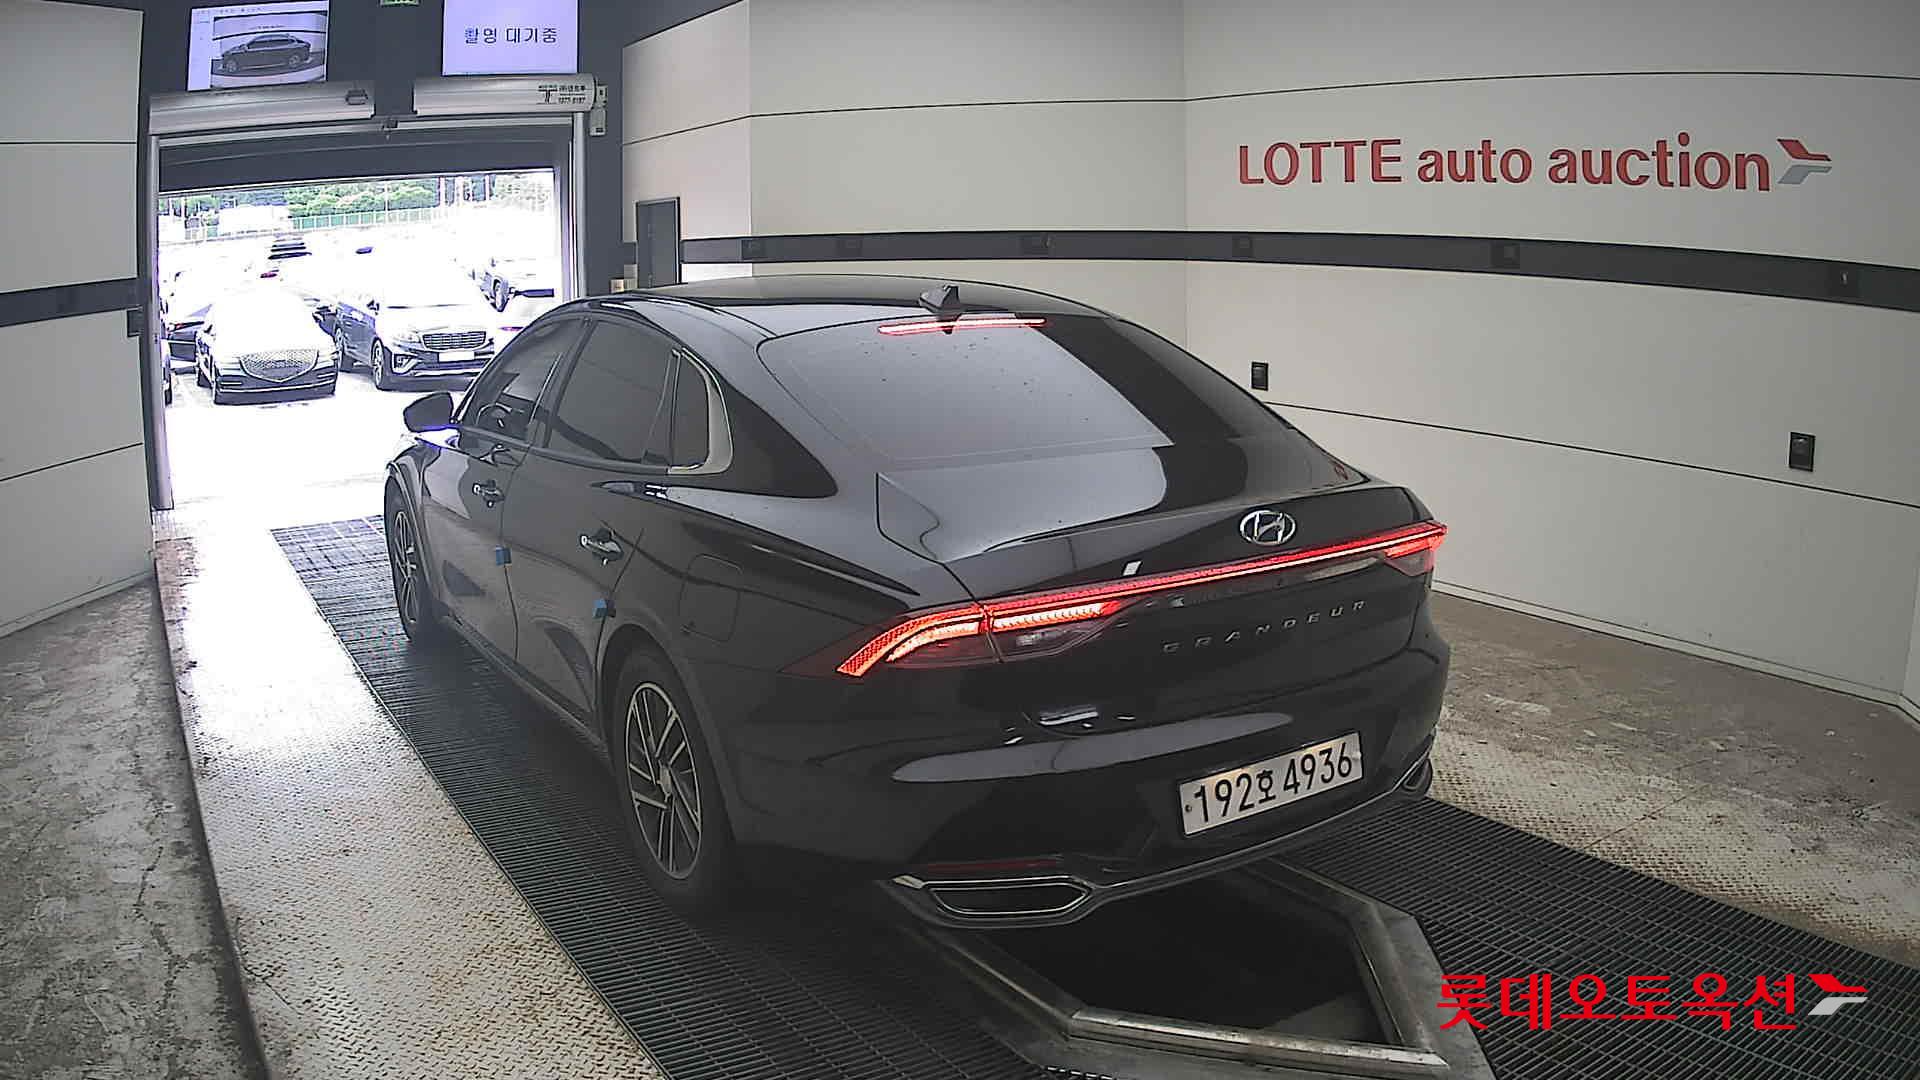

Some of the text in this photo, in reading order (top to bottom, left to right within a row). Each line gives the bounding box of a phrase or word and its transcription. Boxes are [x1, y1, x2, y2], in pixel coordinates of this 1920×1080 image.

[506, 28, 557, 44] 대기중
[1239, 131, 1770, 192] LOTTE auto auction
[1163, 600, 1366, 654] GRANDEUR
[1194, 742, 1352, 823] 192호 4936
